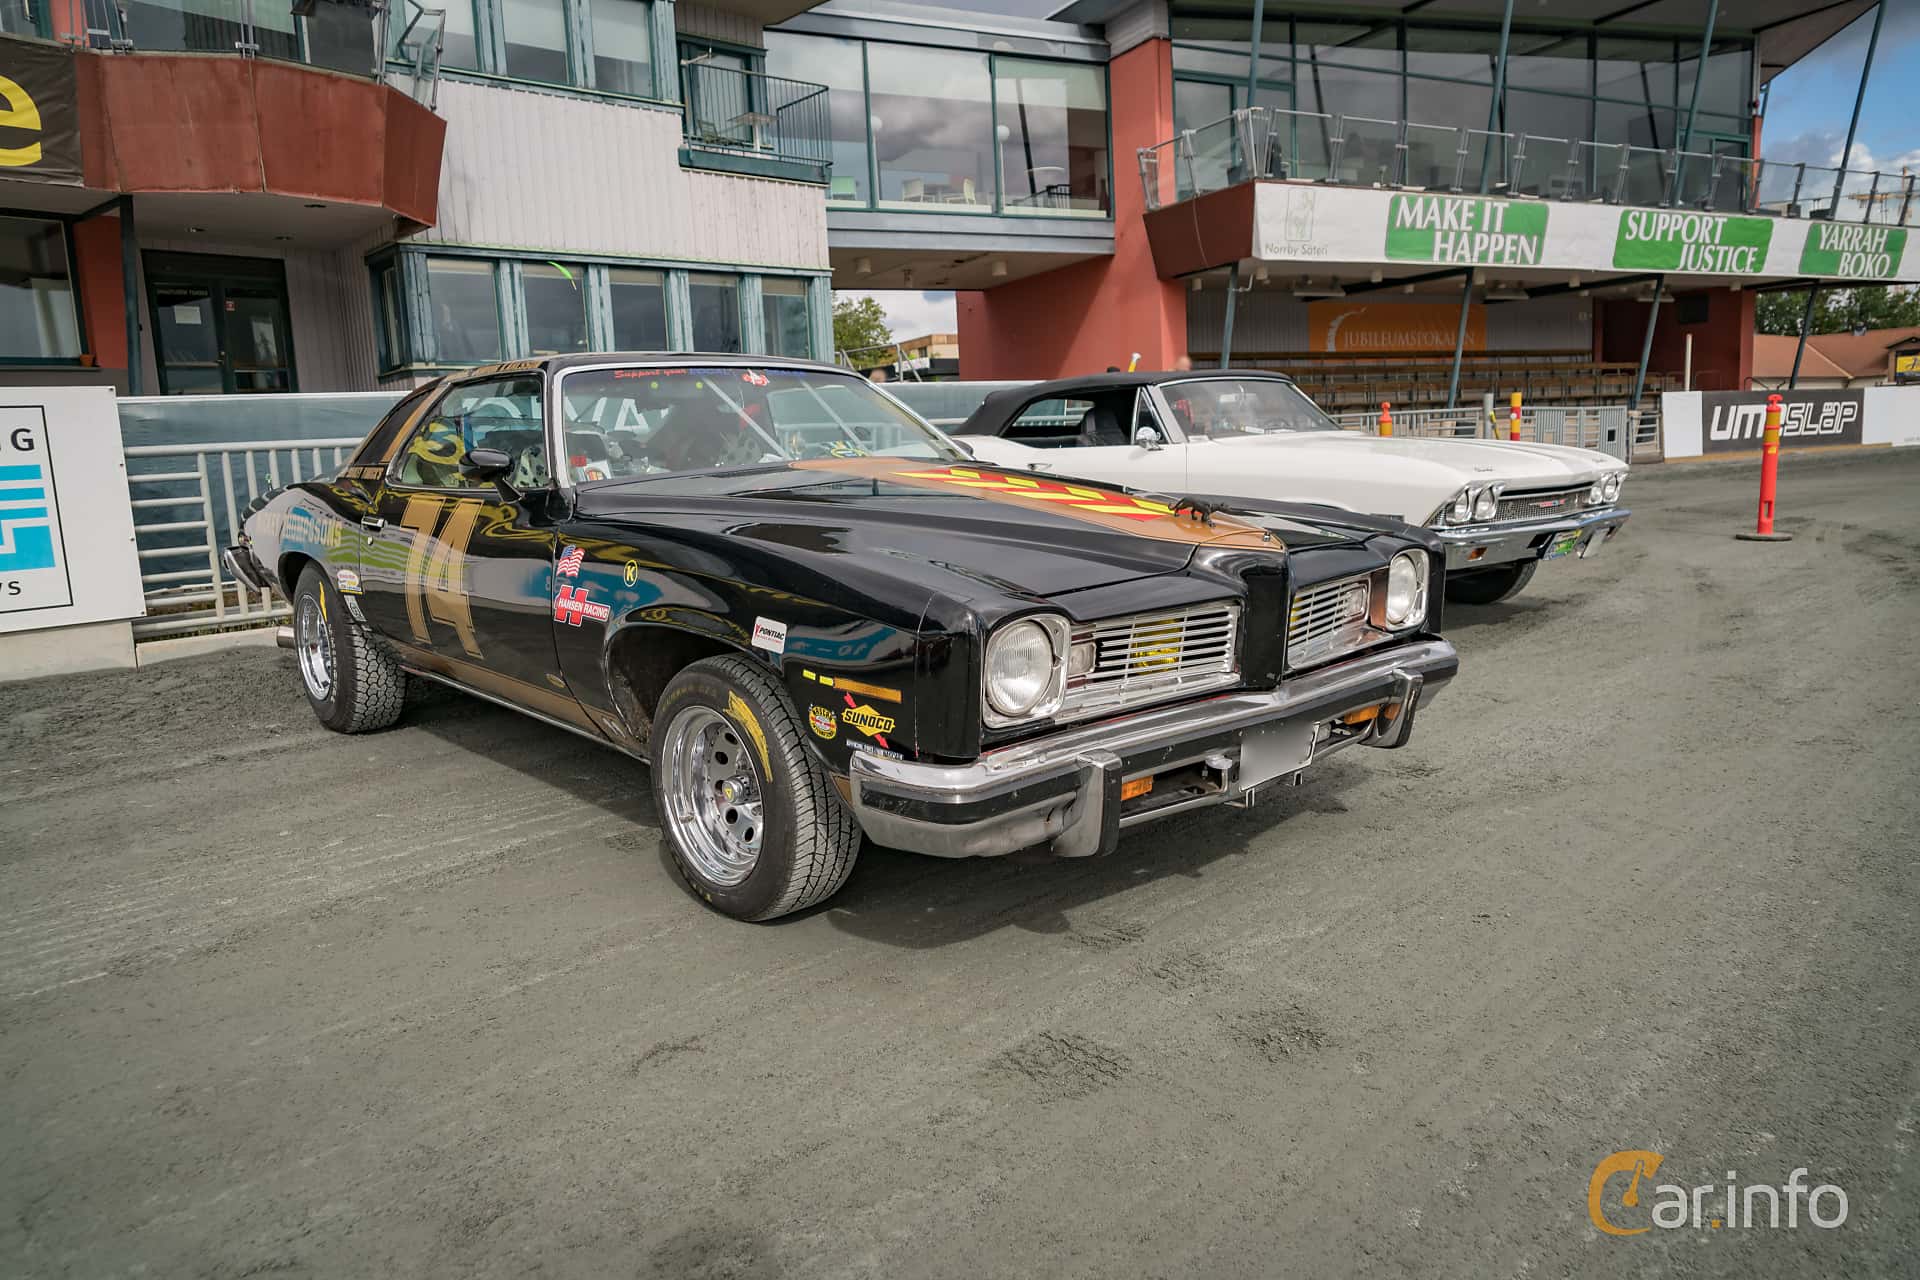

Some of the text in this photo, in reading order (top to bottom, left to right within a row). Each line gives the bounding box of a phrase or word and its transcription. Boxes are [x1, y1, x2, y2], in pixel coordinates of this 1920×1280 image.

[1395, 195, 1509, 233] MAKE IT
[1624, 211, 1727, 244] SUPPORT
[1432, 231, 1538, 265] HAPPEN
[1818, 223, 1888, 253] YARRAH
[1677, 243, 1758, 273] JUSTICE
[1837, 252, 1891, 279] BOKO
[1344, 328, 1475, 349] JUBILEUMSPOKALN
[0, 428, 35, 452] G
[558, 597, 609, 619] HANSEN RACING
[759, 626, 785, 641] PONTIAC
[844, 710, 893, 732] SUNOCO
